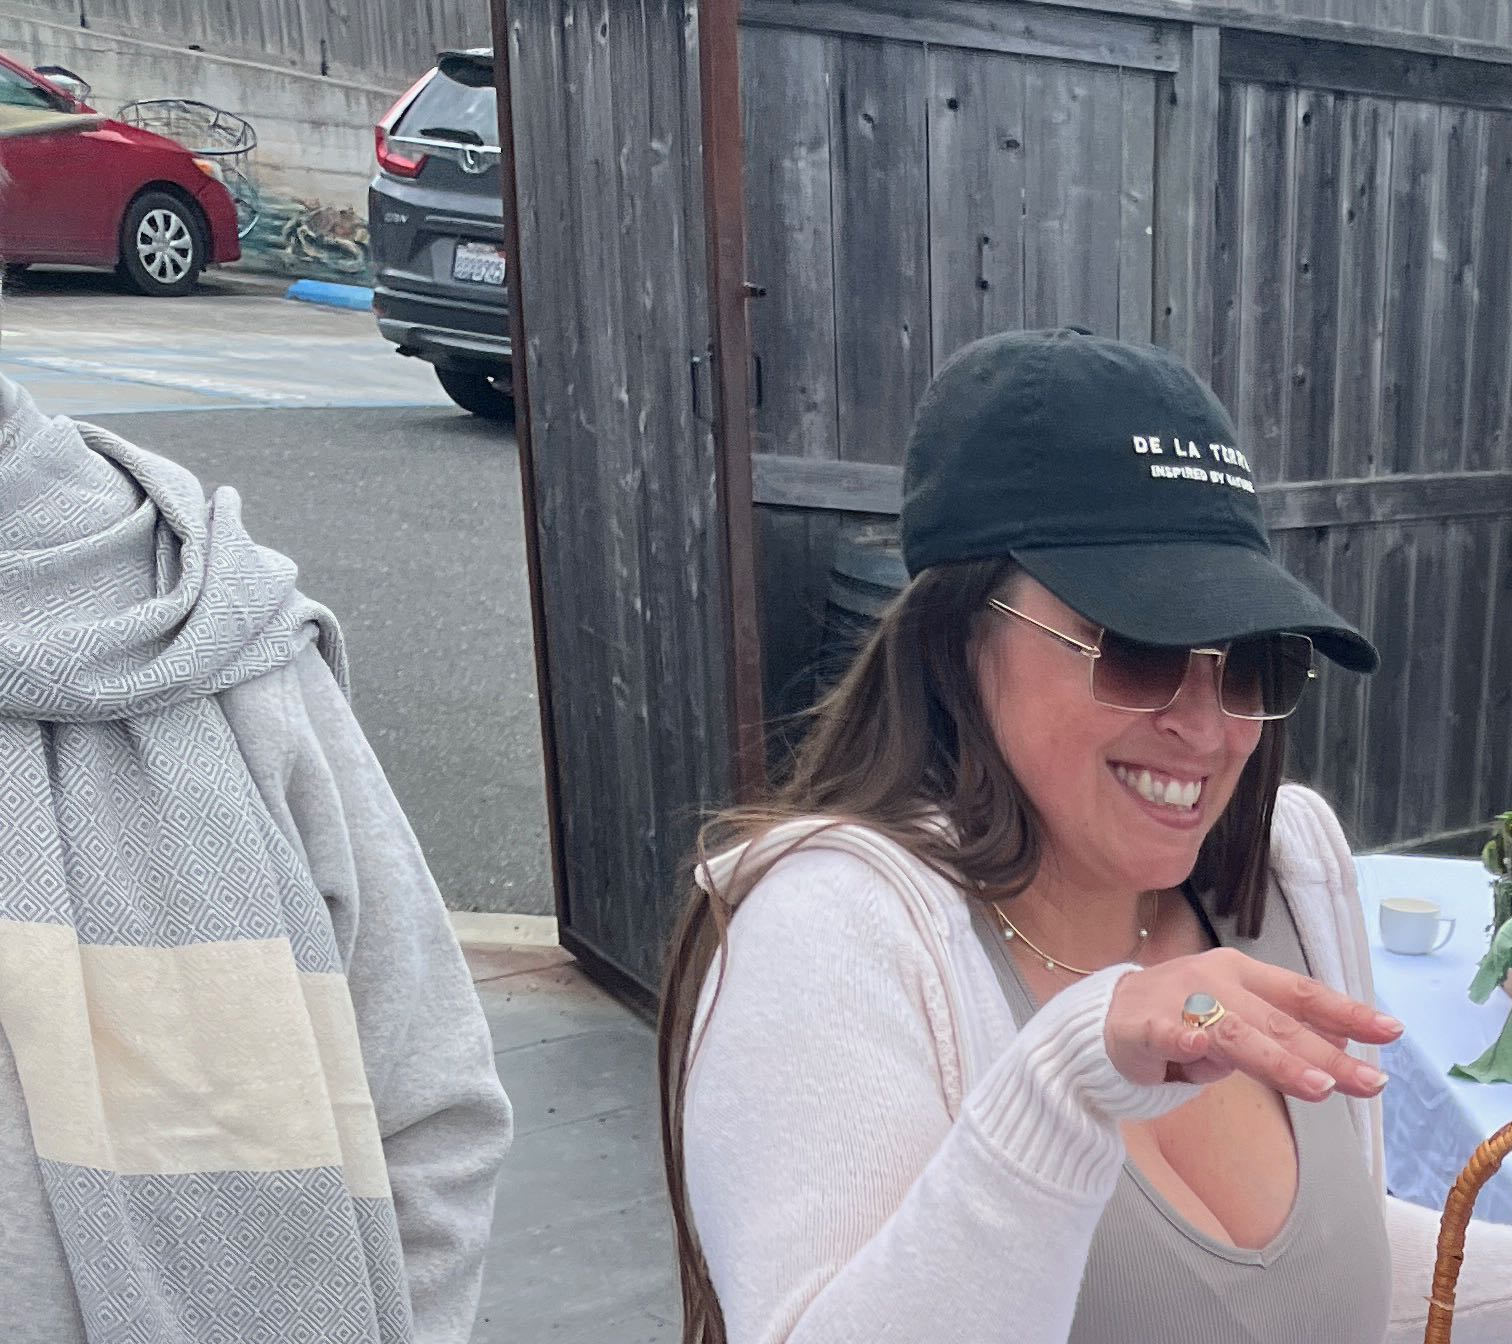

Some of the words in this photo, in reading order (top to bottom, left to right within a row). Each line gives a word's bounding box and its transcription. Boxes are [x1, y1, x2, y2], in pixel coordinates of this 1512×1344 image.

[1132, 435, 1163, 454] DE
[1173, 437, 1201, 459] LA
[1150, 465, 1208, 481] INSPIRED
[1209, 470, 1225, 485] BY
